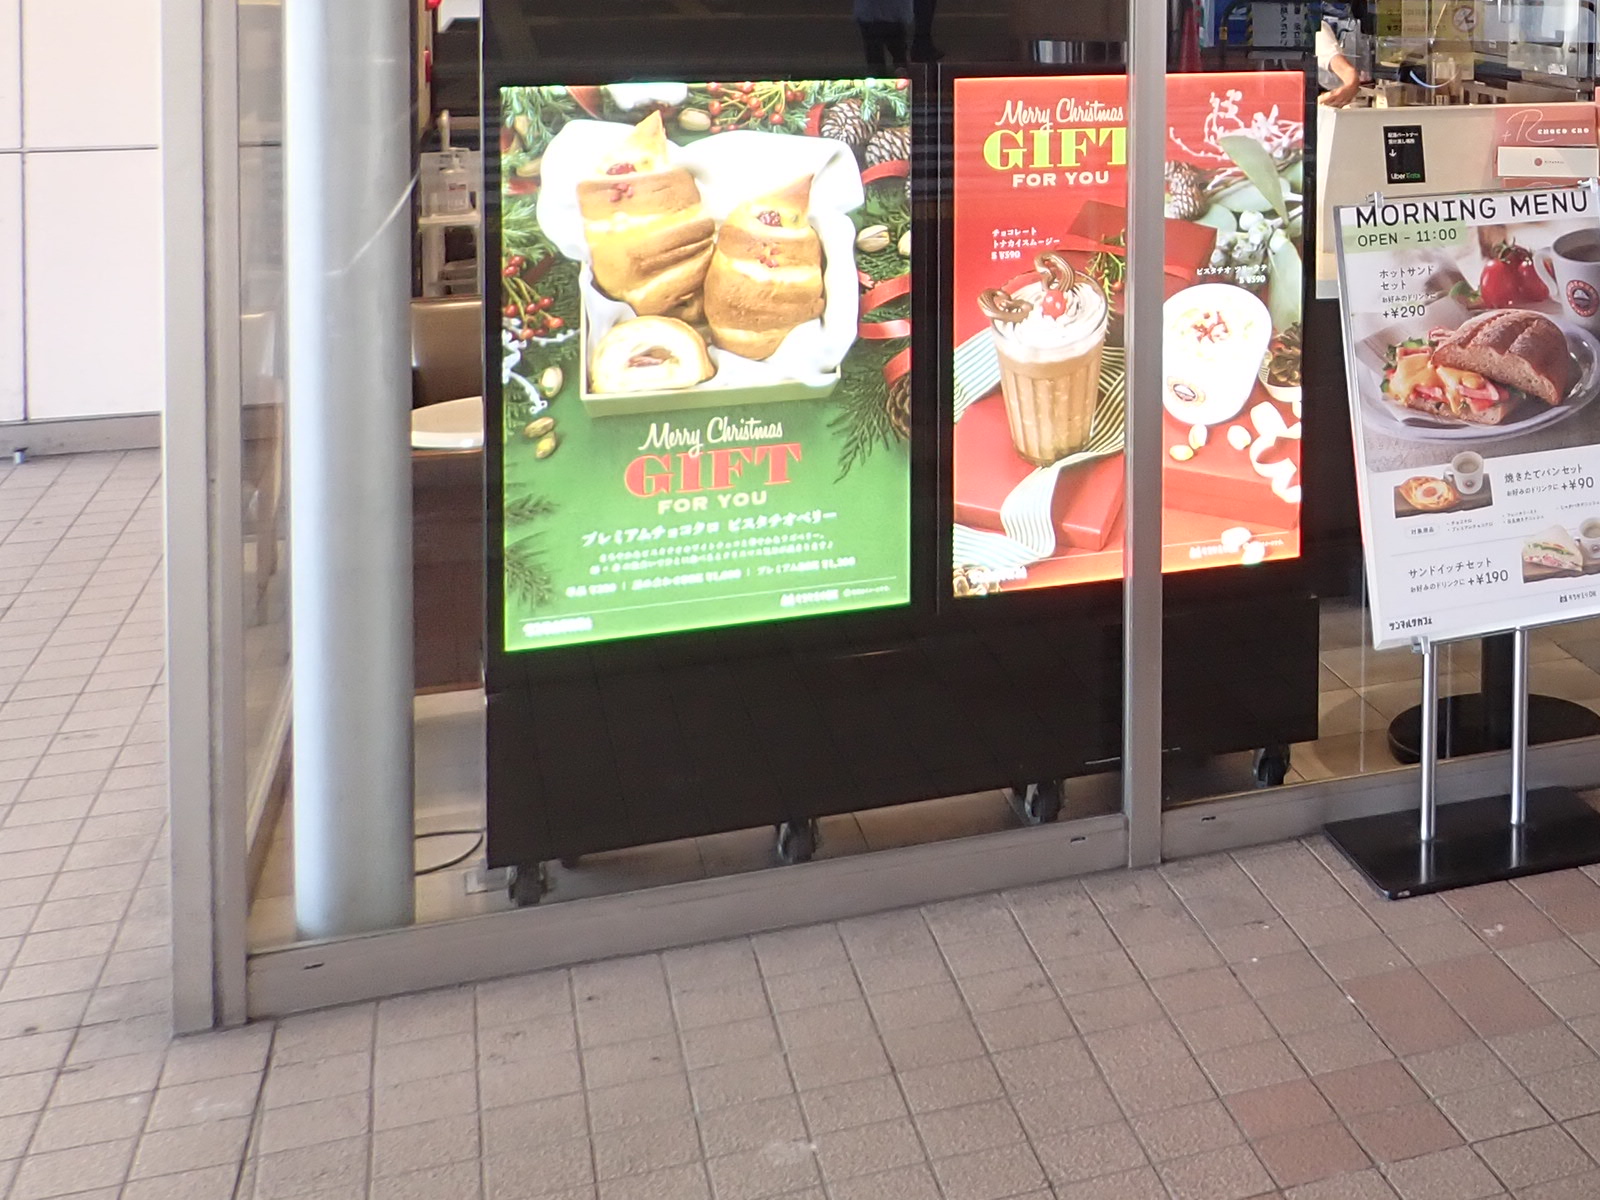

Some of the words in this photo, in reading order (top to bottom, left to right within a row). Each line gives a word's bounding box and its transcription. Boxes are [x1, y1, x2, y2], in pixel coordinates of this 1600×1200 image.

[995, 100, 1051, 132] Merry
[1056, 97, 1124, 124] Christmas
[982, 126, 1127, 171] GIFT
[1012, 173, 1057, 188] FOR
[1065, 170, 1110, 186] YOU
[1356, 197, 1496, 229] MORNING
[1511, 191, 1589, 217] MENU
[991, 227, 1038, 237] チョコレート
[1357, 232, 1398, 247] OPEN
[1416, 228, 1457, 243] 11:00
[1379, 265, 1435, 279] ホットサンド
[1380, 281, 1407, 291] セット
[1382, 304, 1426, 319] +¥290
[638, 422, 704, 457] Merry
[707, 416, 784, 444] Christmas
[624, 442, 803, 498] GIFT
[1504, 463, 1584, 484] 焼きたてパンセット
[1560, 476, 1595, 492] +¥90
[657, 496, 708, 515] FOR
[717, 490, 768, 509] YOU
[581, 521, 720, 548] プレミアムチョコクロ
[727, 509, 838, 533] ピスタチオベリー
[1408, 557, 1493, 579] サンドイッチセット
[1467, 569, 1509, 586] +¥190
